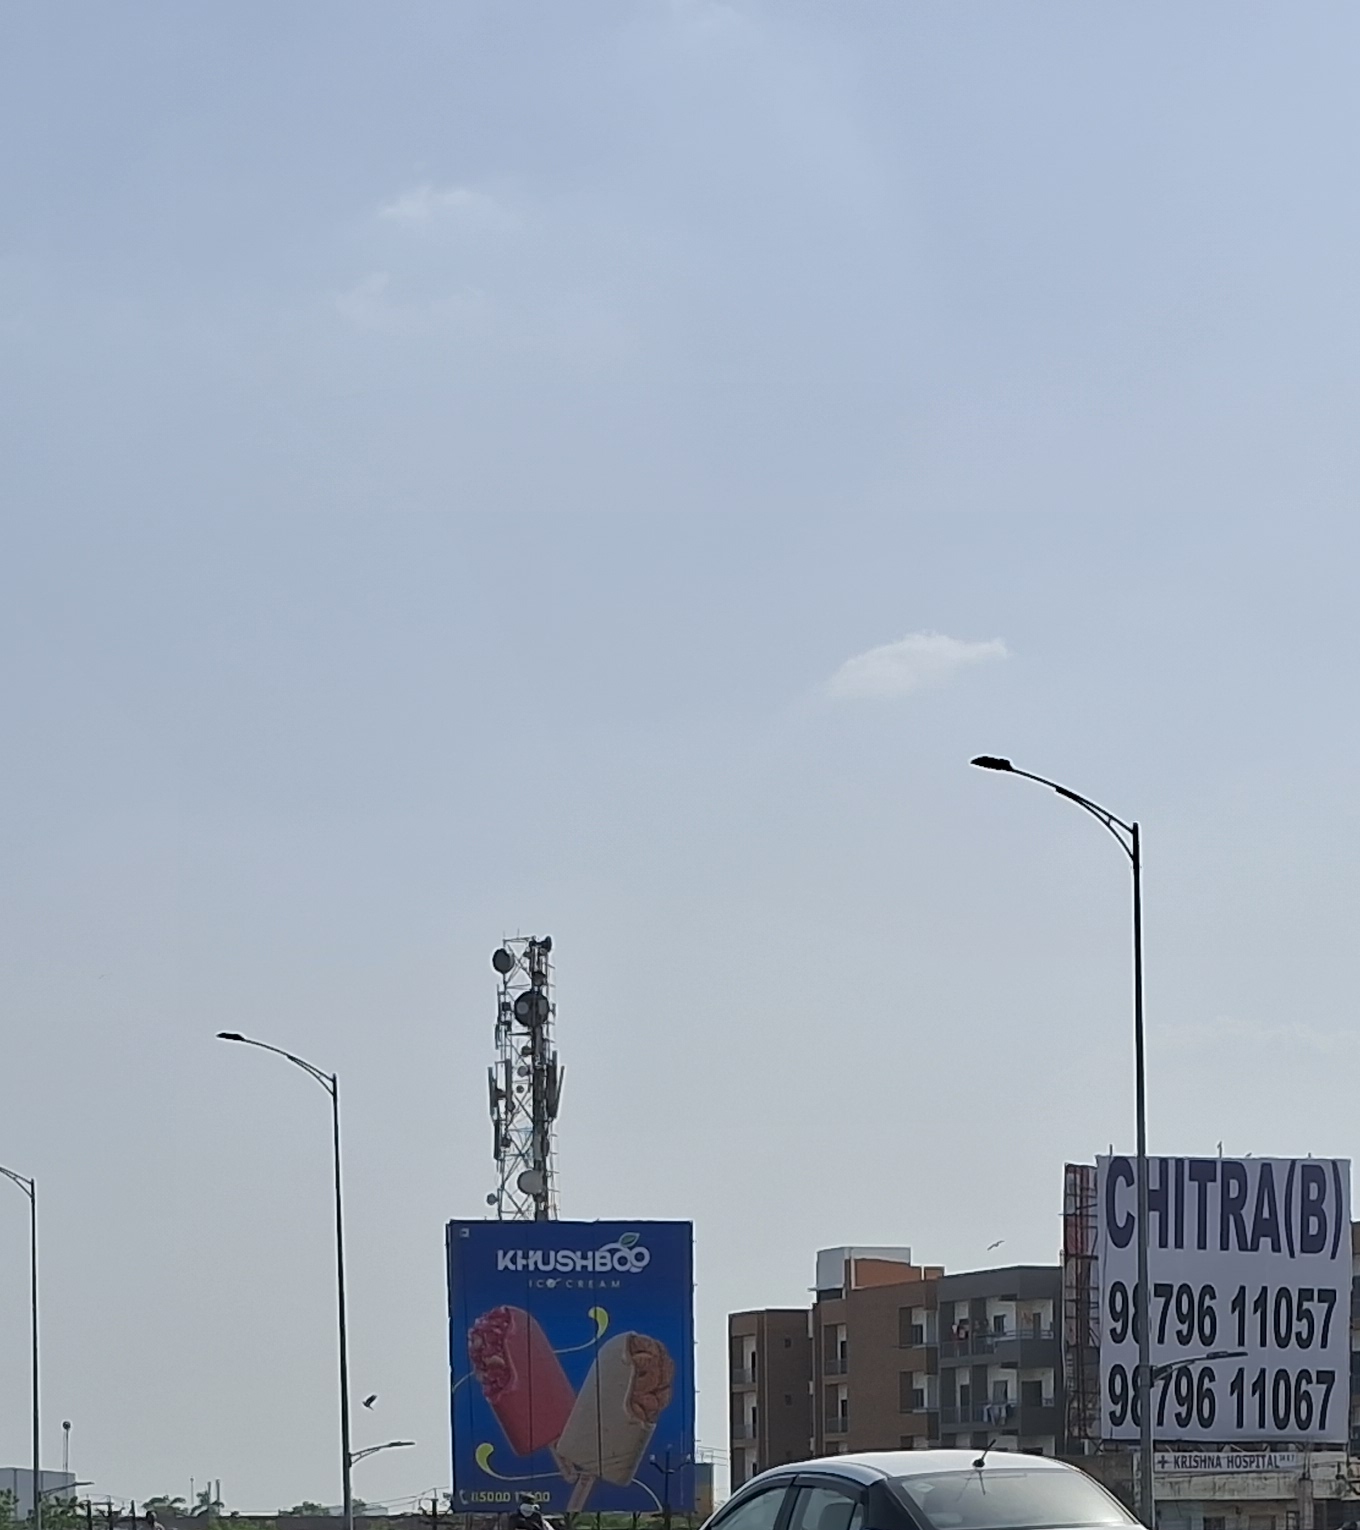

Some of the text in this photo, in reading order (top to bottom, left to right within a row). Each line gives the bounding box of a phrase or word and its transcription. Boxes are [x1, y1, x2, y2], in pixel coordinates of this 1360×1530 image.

[1105, 1157, 1344, 1260] CHITRA(B)
[497, 1246, 650, 1273] KHUSHBOO
[565, 1279, 621, 1289] CREAM
[1230, 1285, 1337, 1350] 11057
[1229, 1367, 1336, 1431] 11067
[1173, 1454, 1221, 1469] KRISHNA
[1227, 1454, 1280, 1469] HOSPITAL
